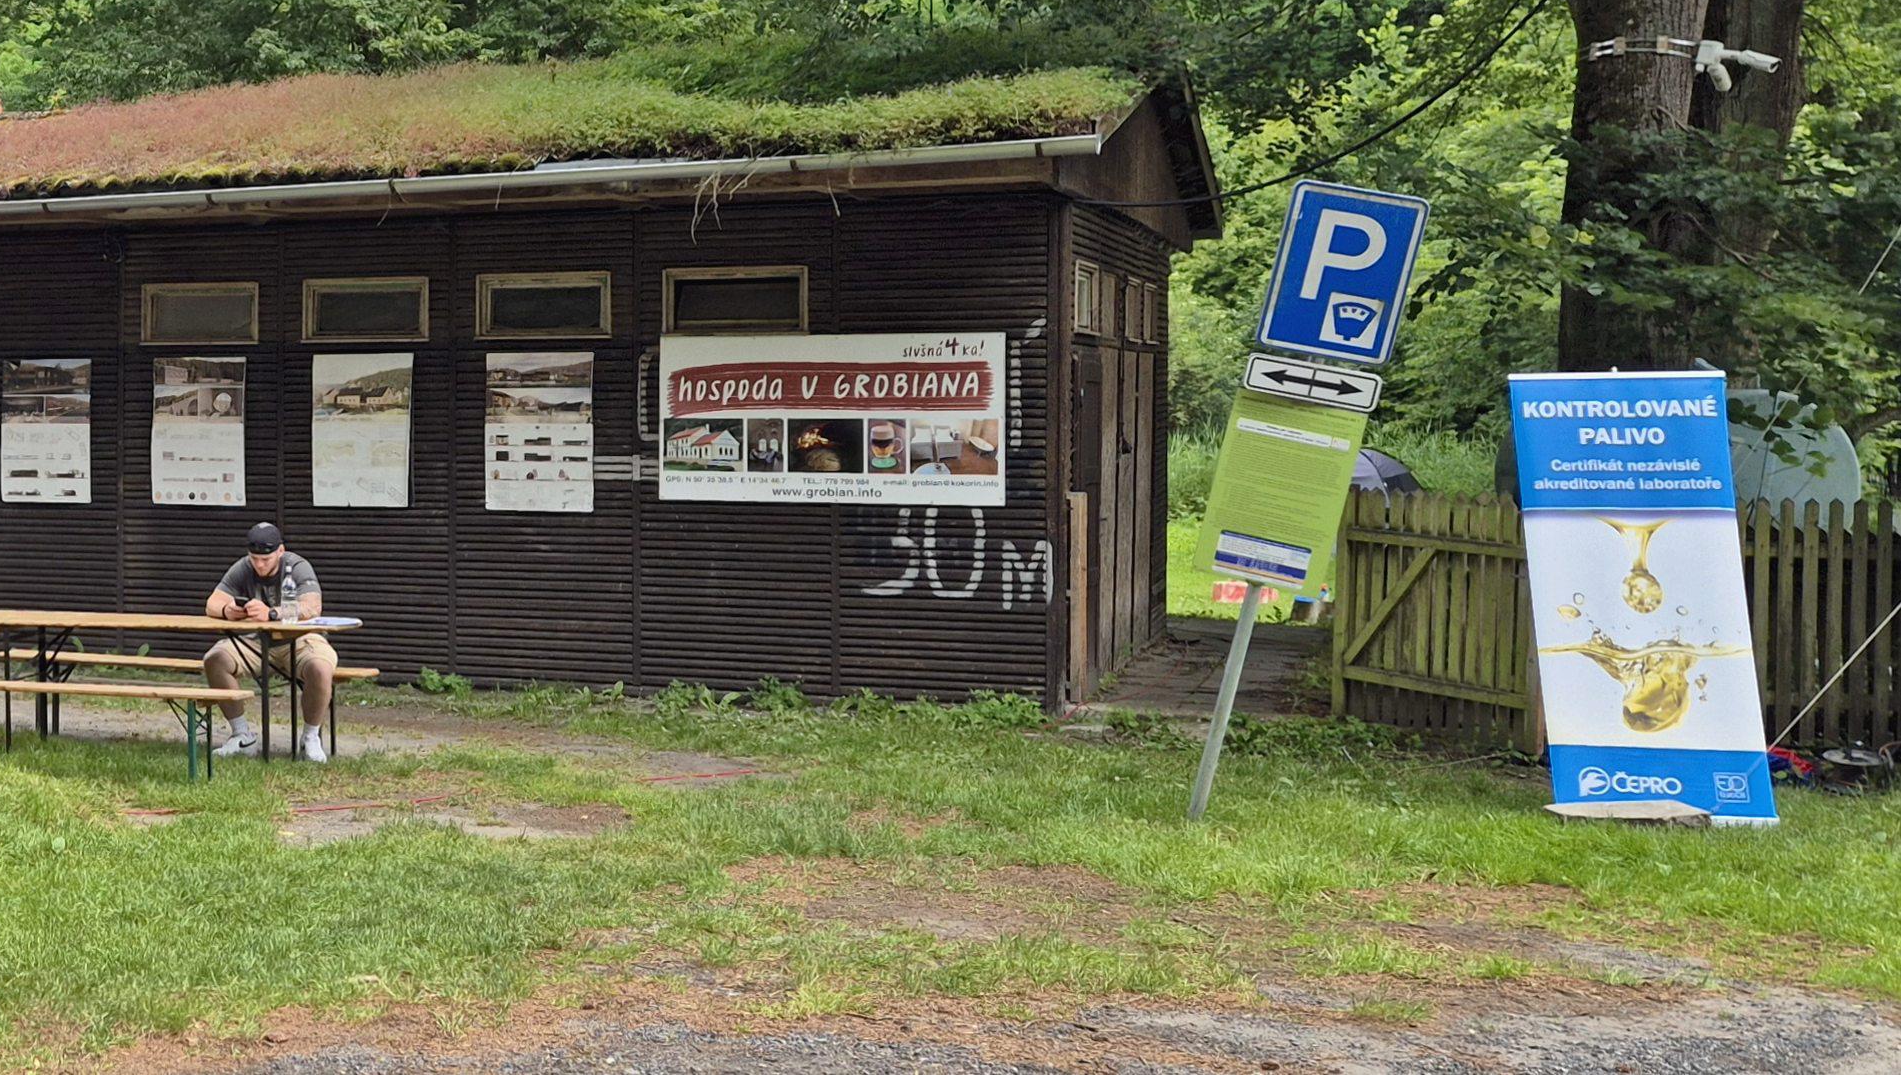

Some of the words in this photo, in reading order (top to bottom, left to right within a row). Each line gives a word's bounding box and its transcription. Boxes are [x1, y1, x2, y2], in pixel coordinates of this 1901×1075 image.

[1299, 208, 1387, 300] P
[678, 374, 783, 405] hospoda
[833, 371, 980, 399] GROBIANA
[1522, 395, 1718, 418] KONTROLOVANÉ
[1579, 427, 1665, 445] PALIVO
[1551, 458, 1624, 472] Certifikát
[1627, 457, 1700, 472] nezávislé
[772, 486, 883, 499] www.grobian.info
[1534, 478, 1635, 491] akreditované
[1639, 477, 1722, 491] laboratoře
[1612, 771, 1682, 795] ČEPRO
